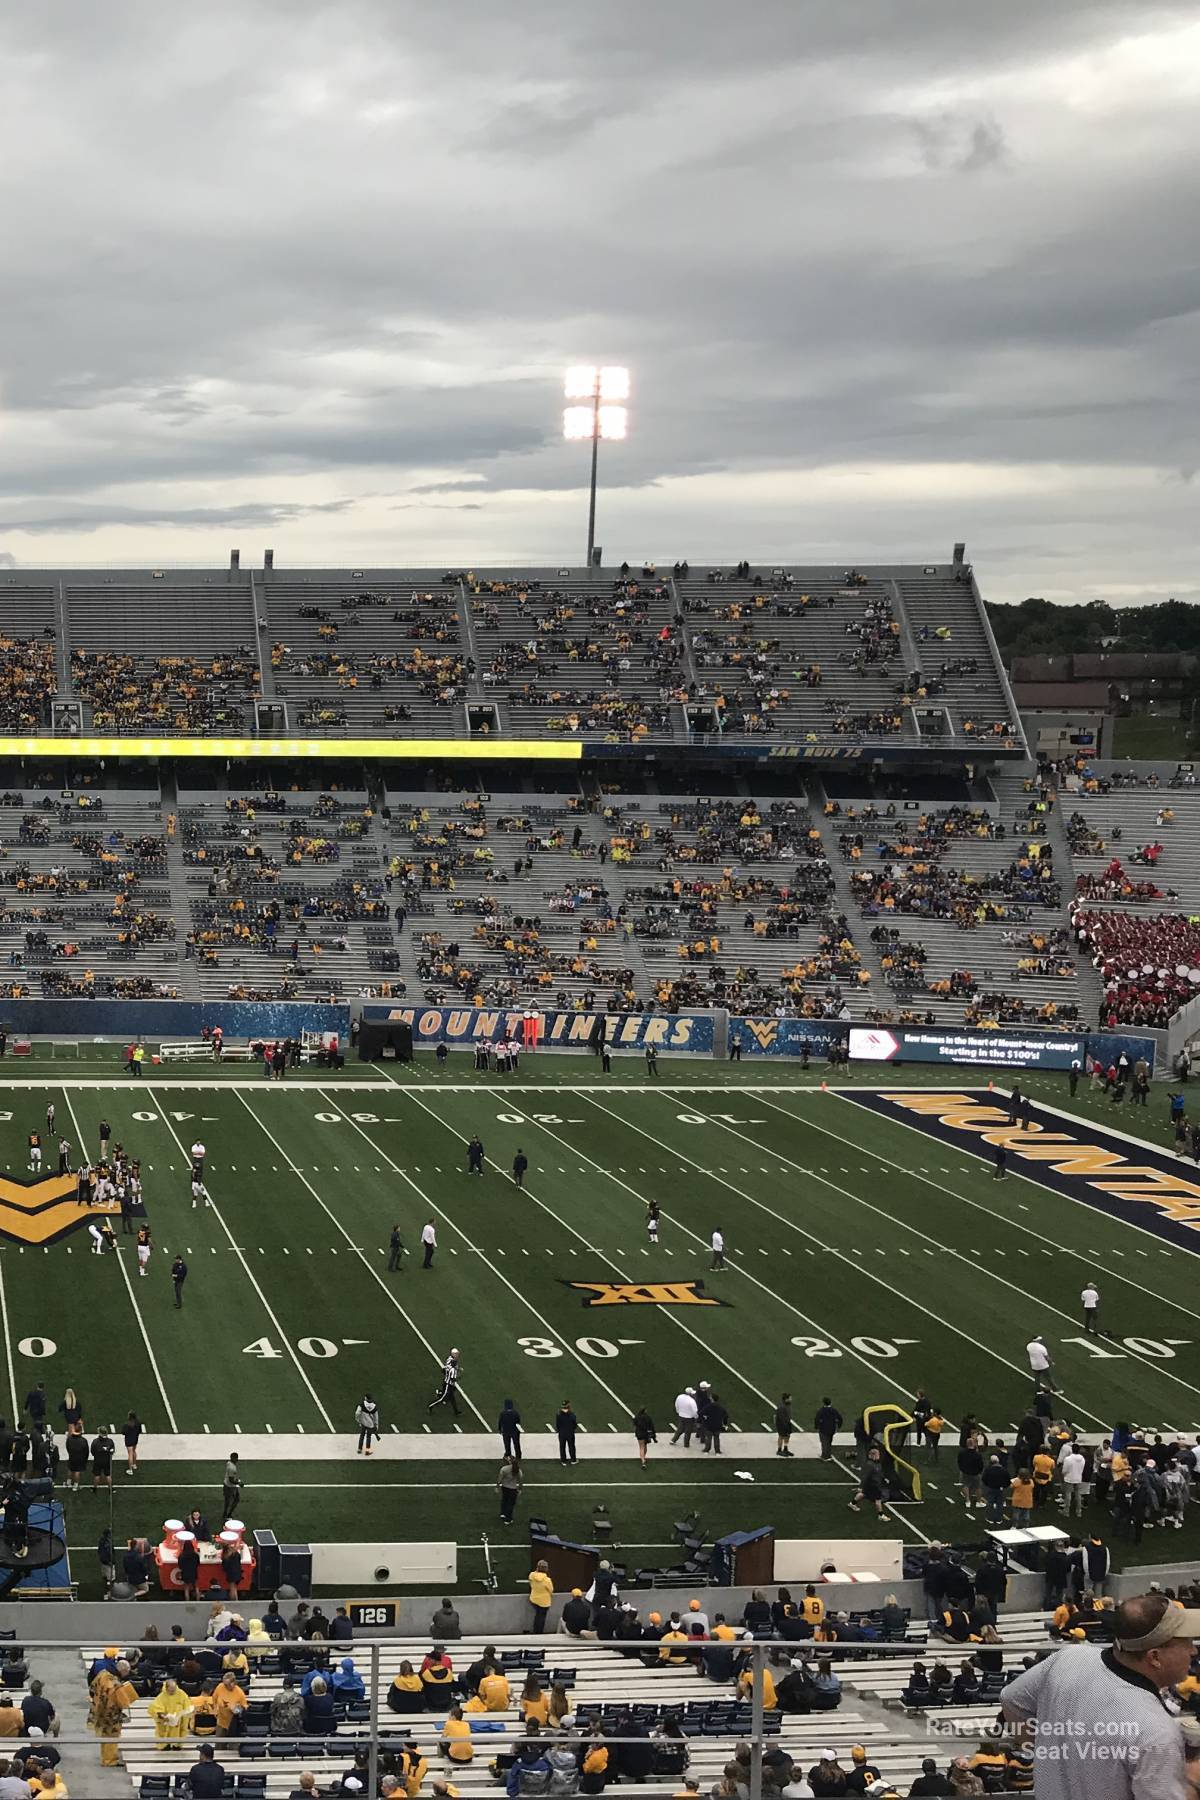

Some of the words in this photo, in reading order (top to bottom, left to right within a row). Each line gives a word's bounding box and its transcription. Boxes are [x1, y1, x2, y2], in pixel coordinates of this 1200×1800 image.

[769, 747, 800, 757] SAM
[803, 747, 841, 758] HUFF
[843, 747, 863, 758] 75
[787, 1034, 831, 1043] NISSAN
[946, 1036, 954, 1044] in
[954, 1036, 967, 1045] the
[968, 1037, 989, 1046] Heart
[989, 1038, 998, 1047] of
[1046, 1041, 1078, 1053] Country!
[939, 1046, 977, 1058] Starting
[978, 1047, 988, 1056] in
[989, 1048, 1006, 1058] the
[241, 1336, 339, 1359] 40
[516, 1336, 619, 1359] 30
[790, 1335, 900, 1359] 20
[1060, 1336, 1178, 1359] 10
[359, 1608, 387, 1625] 126
[811, 1601, 820, 1615] 8
